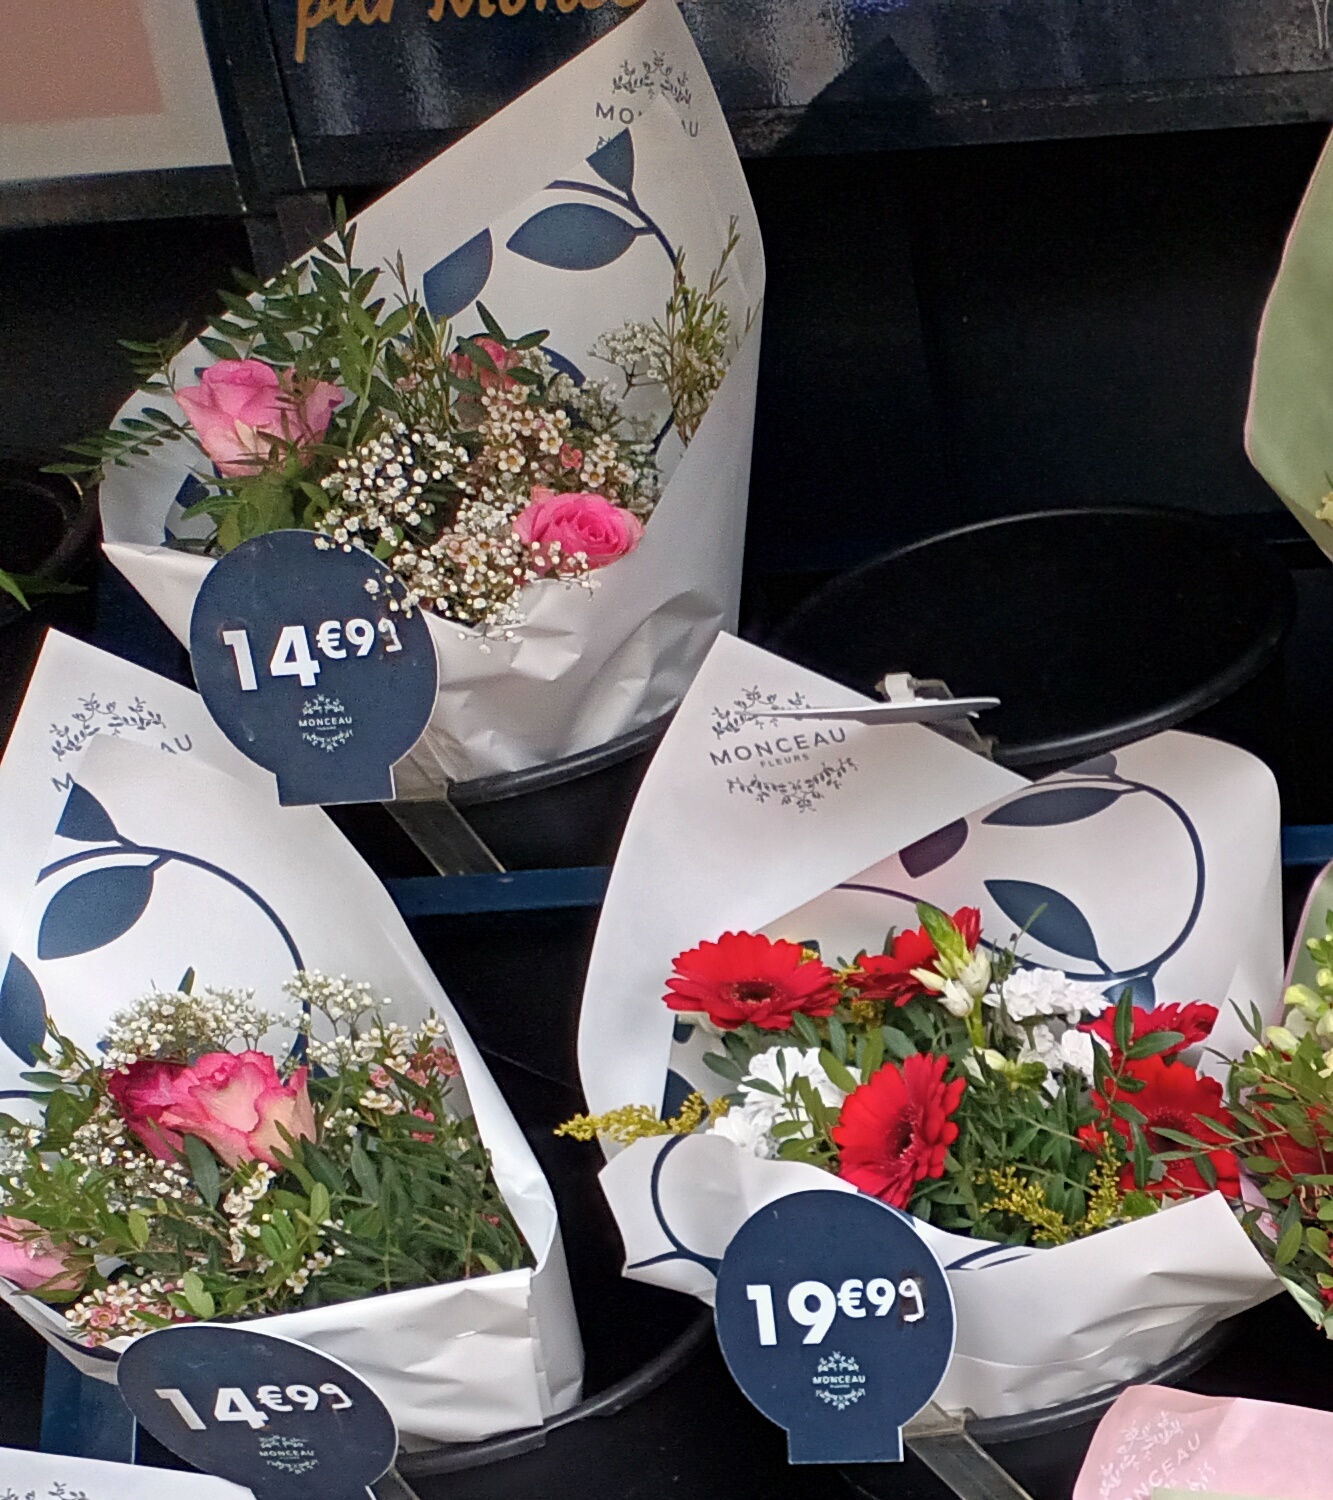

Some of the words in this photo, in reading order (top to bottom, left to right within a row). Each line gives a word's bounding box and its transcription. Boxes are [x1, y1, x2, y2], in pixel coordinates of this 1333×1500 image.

[222, 617, 403, 691] 14€99
[298, 716, 353, 727] MONCEAU
[709, 727, 847, 766] MONCEAU
[760, 753, 811, 768] FLEURS
[746, 1277, 925, 1346] 19€99
[812, 1374, 866, 1385] MONCEAU
[155, 1382, 353, 1431] 14€99
[258, 1449, 315, 1457] MONCEAU
